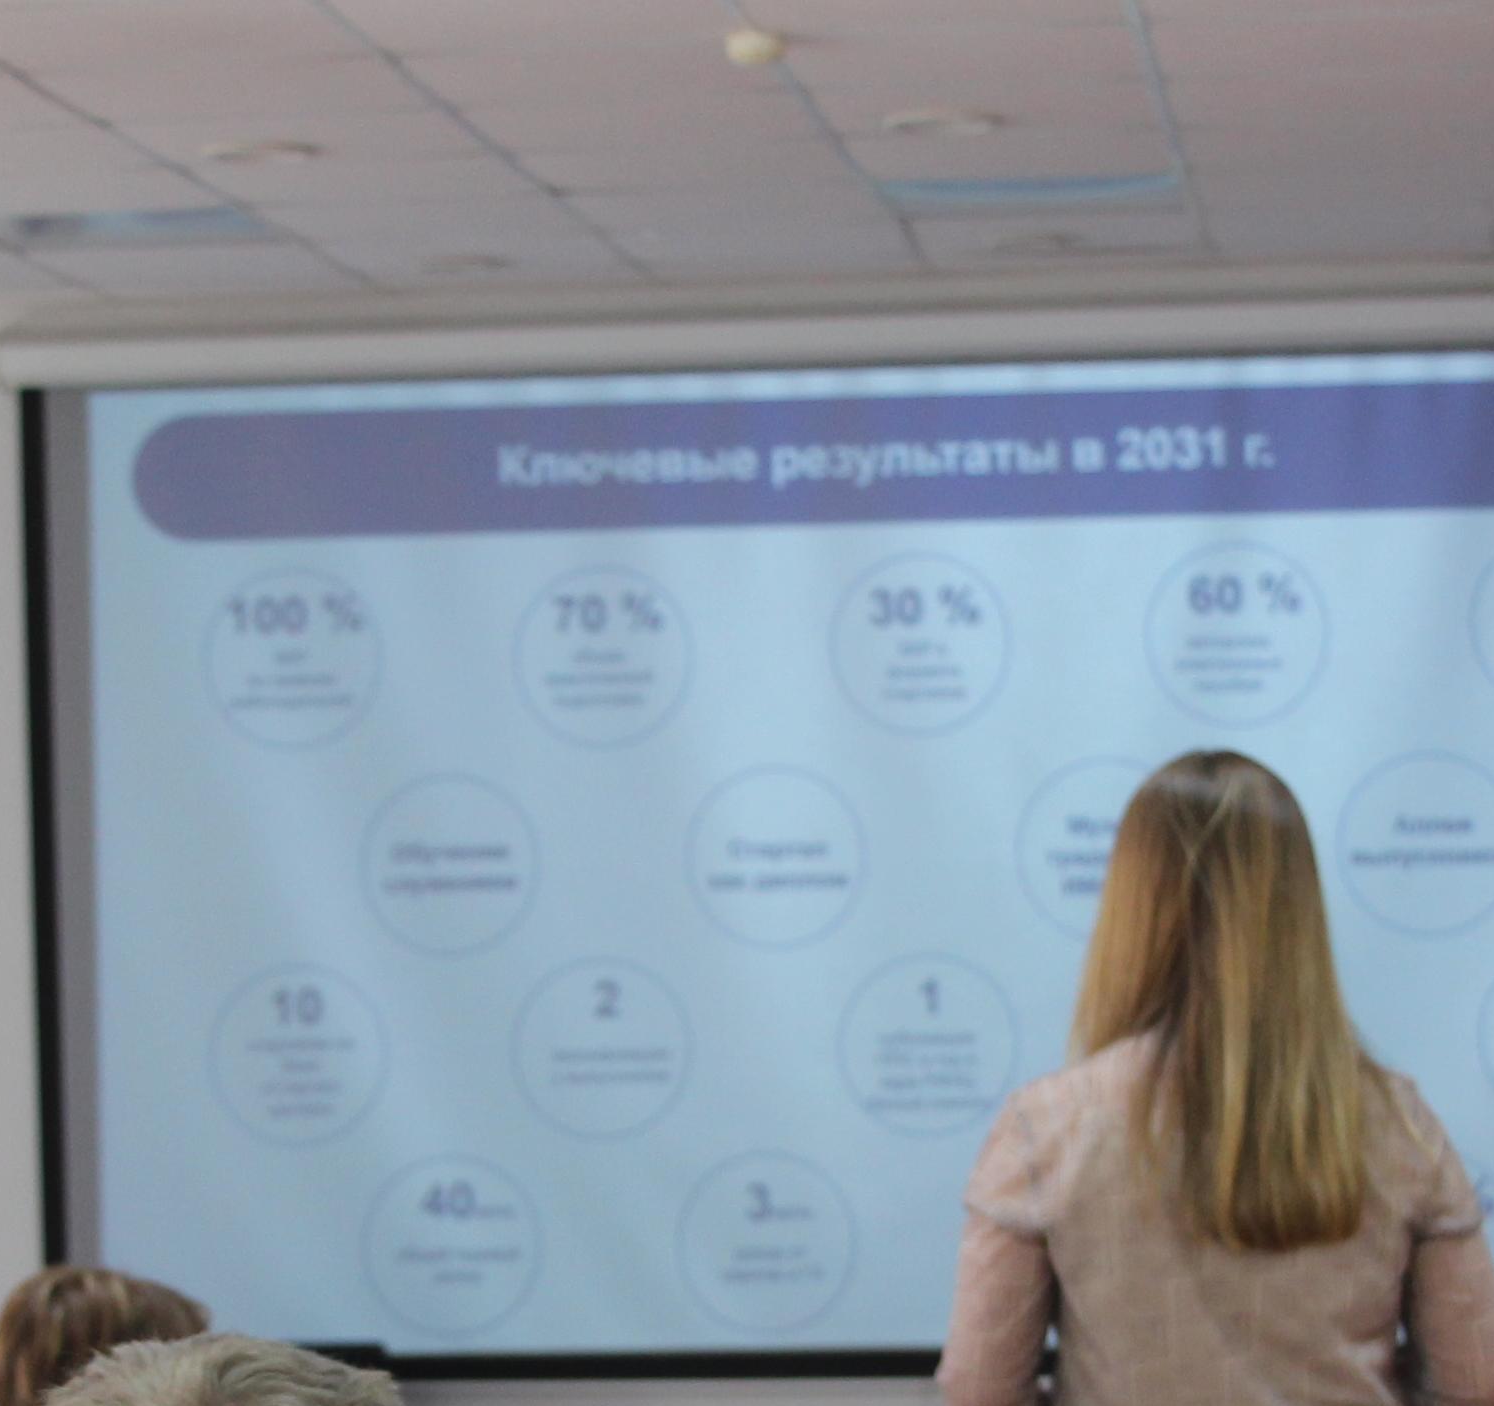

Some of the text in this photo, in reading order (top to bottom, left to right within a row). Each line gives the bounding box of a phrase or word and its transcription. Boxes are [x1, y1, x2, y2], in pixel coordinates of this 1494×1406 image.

[498, 424, 1277, 490] Ключевые результаты в 2031 г.
[225, 591, 309, 637] 100
[551, 591, 608, 636] 70
[867, 584, 923, 629] 30
[1186, 573, 1245, 618] 60
[273, 983, 324, 1029] 10
[593, 977, 622, 1021] 2
[917, 975, 942, 1017] 1
